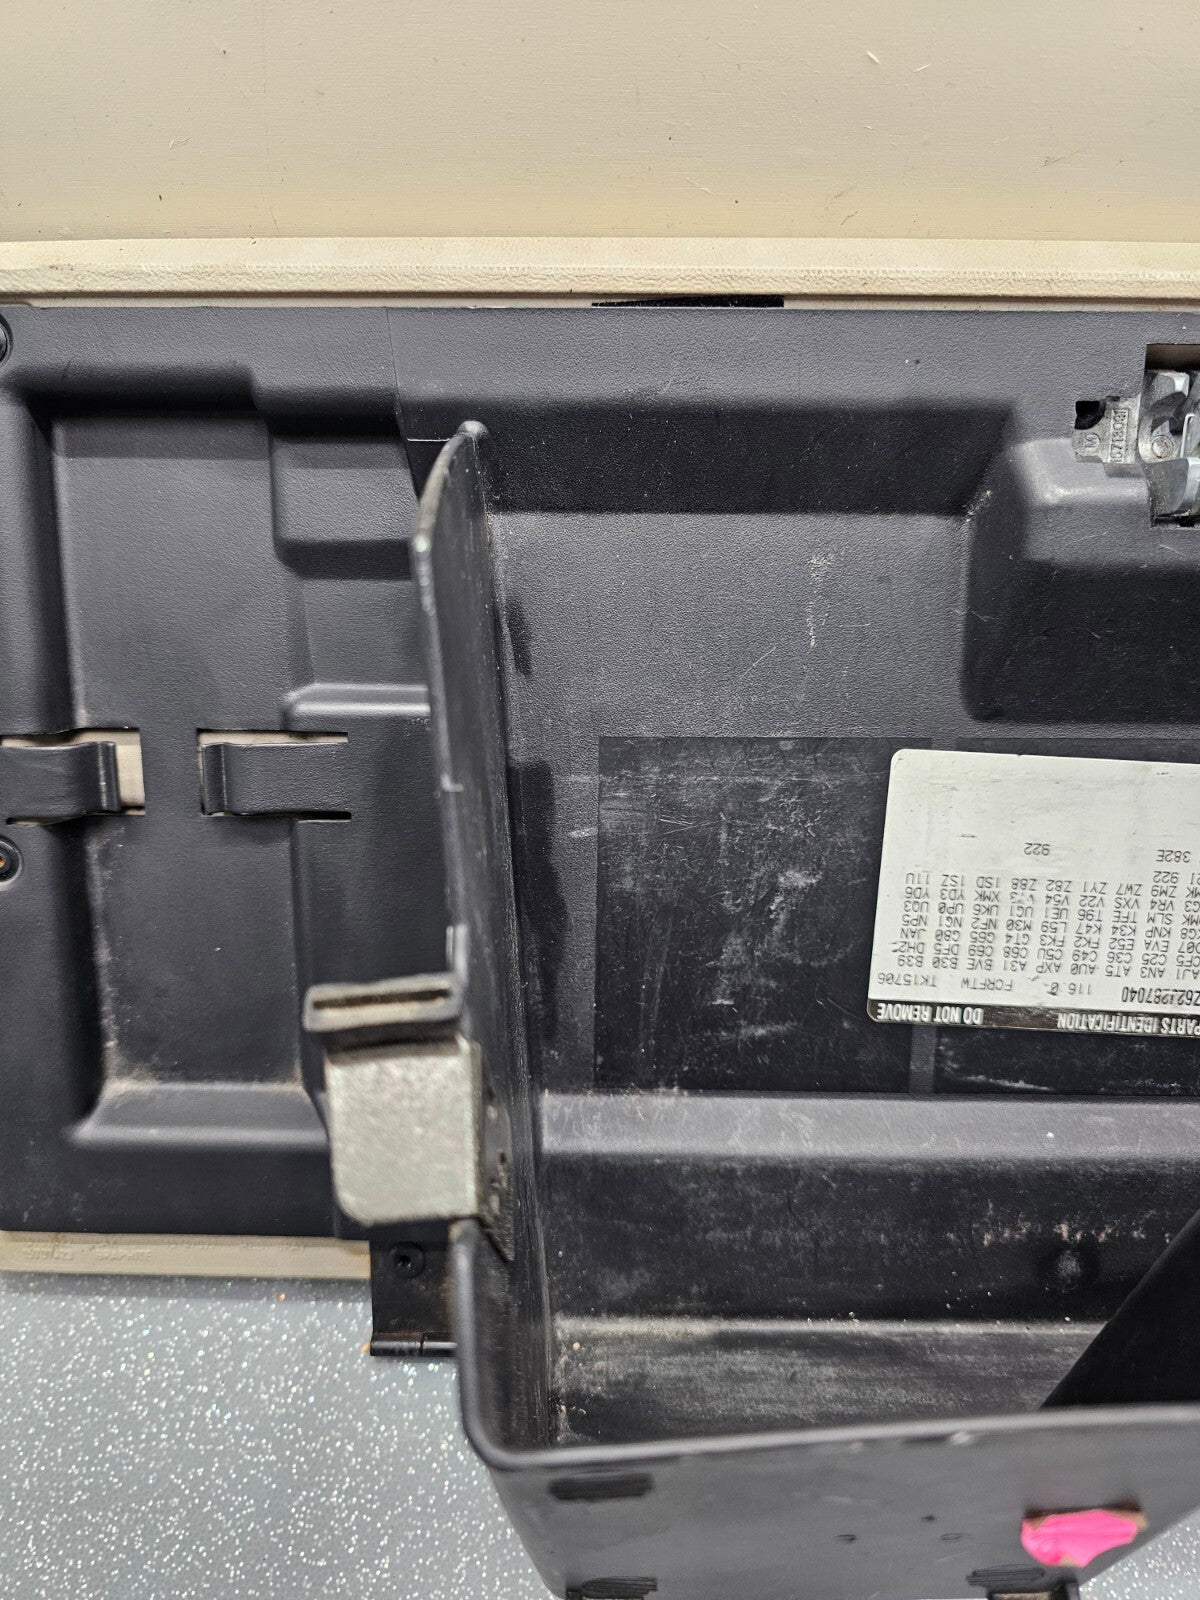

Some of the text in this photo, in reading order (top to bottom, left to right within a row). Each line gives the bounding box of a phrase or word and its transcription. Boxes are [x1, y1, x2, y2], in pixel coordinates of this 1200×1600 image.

[1024, 843, 1050, 855] 922
[1156, 849, 1190, 862] 382E
[1153, 870, 1179, 883] 922
[1011, 878, 1036, 890] Z88
[1046, 879, 1071, 892] Z82
[1081, 881, 1106, 893] ZY1
[1116, 882, 1141, 895] ZW7
[1151, 884, 1176, 897] ZM9
[905, 887, 930, 900] YD6
[940, 889, 965, 901] YD3
[974, 890, 1000, 903] XMK
[1044, 893, 1070, 906] V54
[1079, 895, 1105, 907] V22
[1114, 896, 1140, 909] VXS
[1149, 898, 1175, 911] VR4
[939, 902, 964, 915] UP0
[973, 904, 999, 916] UK6
[1008, 905, 1034, 918] UG1
[1043, 907, 1069, 920] UE1
[1078, 909, 1104, 921] T96
[902, 914, 928, 927] NP5
[937, 916, 963, 929] NG1
[1113, 910, 1138, 923] TFE
[1147, 912, 1173, 924] SLM
[972, 918, 997, 930] NF2
[1006, 919, 1032, 932] M30
[1041, 921, 1067, 933] L59
[1076, 922, 1102, 935] K47
[1111, 924, 1137, 936] K34
[901, 928, 926, 941] JAN
[935, 930, 961, 942] G80
[970, 931, 996, 944] G65
[1146, 925, 1171, 938] KNP
[1005, 933, 1031, 945] GT4
[1040, 934, 1065, 947] FK3
[1074, 936, 1100, 948] FK2
[1109, 937, 1135, 950] E52
[1144, 939, 1169, 952] EVA
[933, 943, 959, 955] DF5
[968, 944, 994, 957] C69
[1003, 946, 1028, 958] C68
[1037, 947, 1063, 960] C5U
[1072, 949, 1098, 962] C49
[1107, 951, 1132, 963] C36
[1141, 952, 1167, 965] C25
[897, 955, 1200, 980] AJ1 AN3 AT5 AU0 AXP A31 BVE B30 B39
[877, 973, 937, 987] TK15706
[960, 977, 1013, 991] FCRFTW
[877, 1002, 983, 1024] DO NOT REMOVE
[1057, 1013, 1158, 1031] IDENTIFICATION
